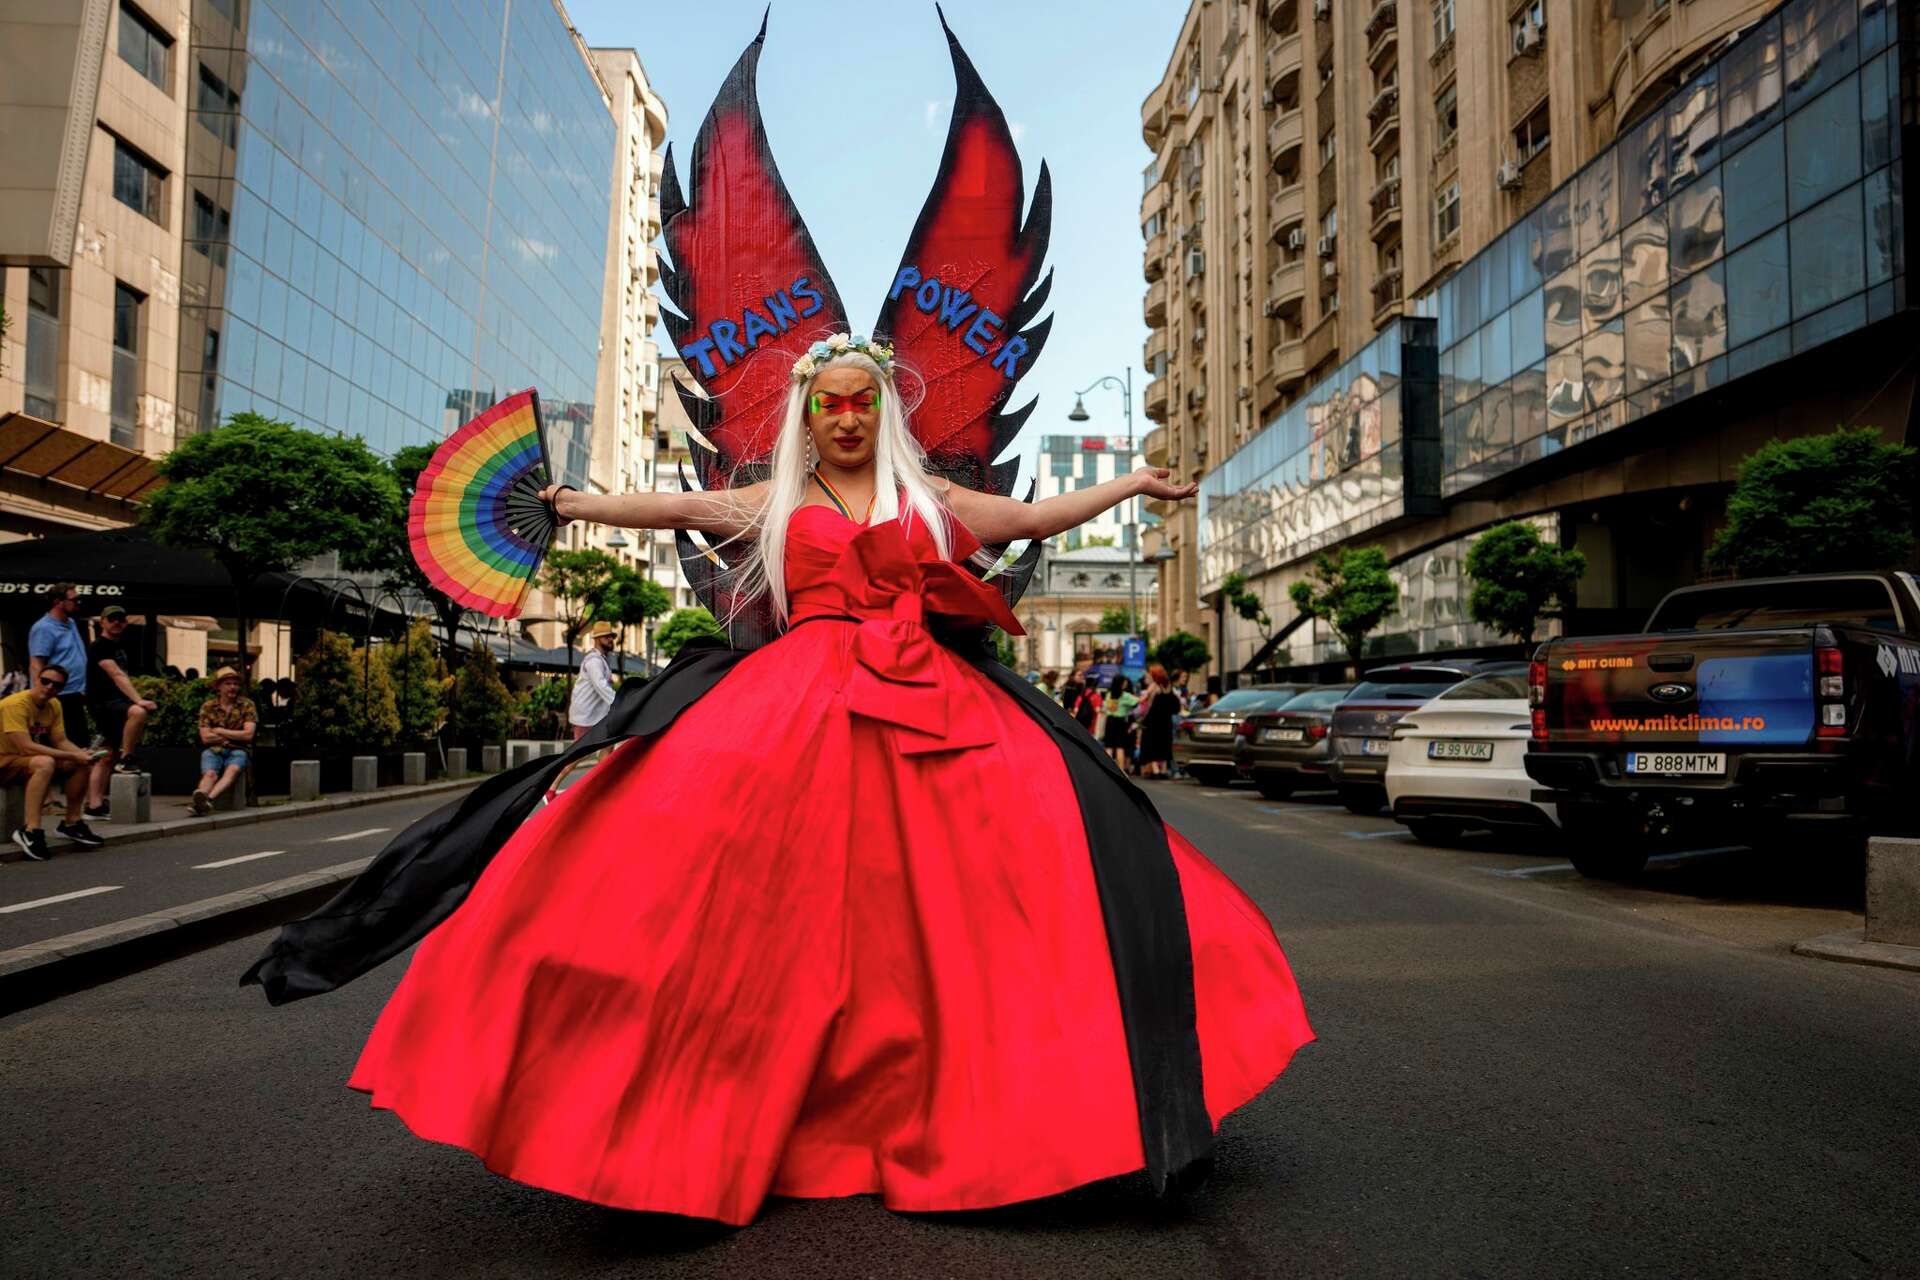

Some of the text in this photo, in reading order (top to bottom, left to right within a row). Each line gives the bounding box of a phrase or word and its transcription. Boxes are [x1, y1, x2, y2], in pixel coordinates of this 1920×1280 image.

[680, 276, 824, 379] TRANS
[889, 266, 1030, 379] POWER
[1128, 643, 1141, 658] P
[1578, 657, 1633, 669] MIT CLIMA
[1590, 713, 1766, 731] www.mitclima.ro
[1437, 743, 1445, 755] B
[1636, 755, 1649, 771] B
